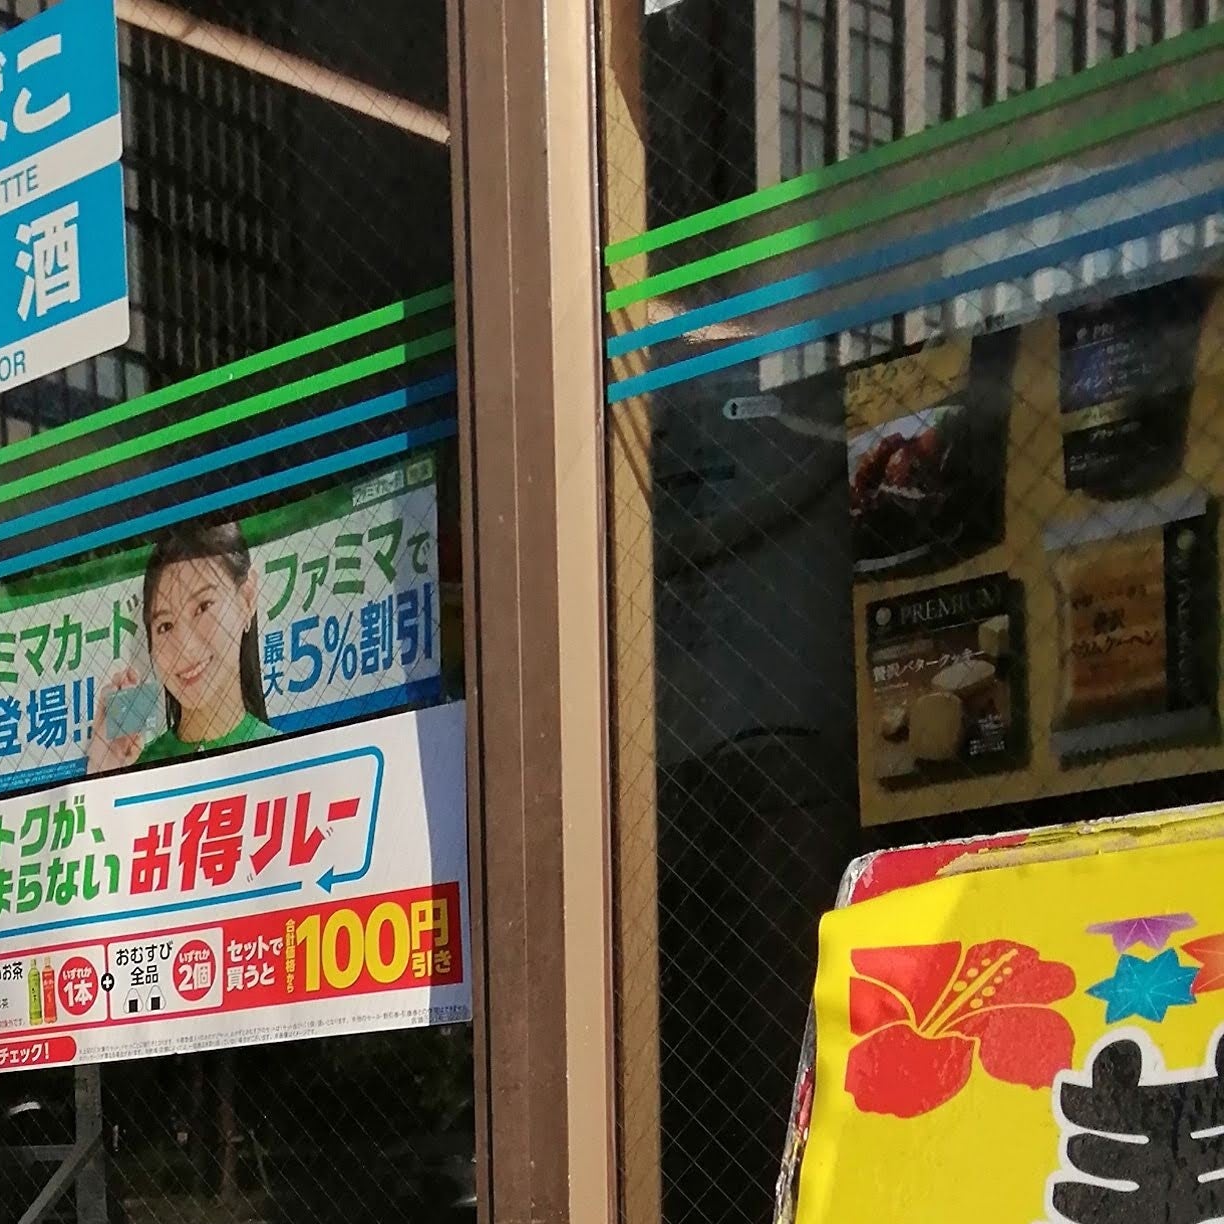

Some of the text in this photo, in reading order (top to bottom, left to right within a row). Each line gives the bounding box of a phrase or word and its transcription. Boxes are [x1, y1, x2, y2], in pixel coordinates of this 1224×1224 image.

[265, 518, 430, 621] ファミマで
[130, 792, 360, 895] お得リレー
[116, 940, 174, 966] おむすび
[179, 949, 211, 963] いずれか
[227, 935, 283, 962] セットで
[62, 967, 92, 980] いずれか
[130, 965, 159, 986] 全品
[178, 961, 212, 992] 2個
[227, 962, 275, 992] 買うと
[63, 979, 93, 1007] 1本
